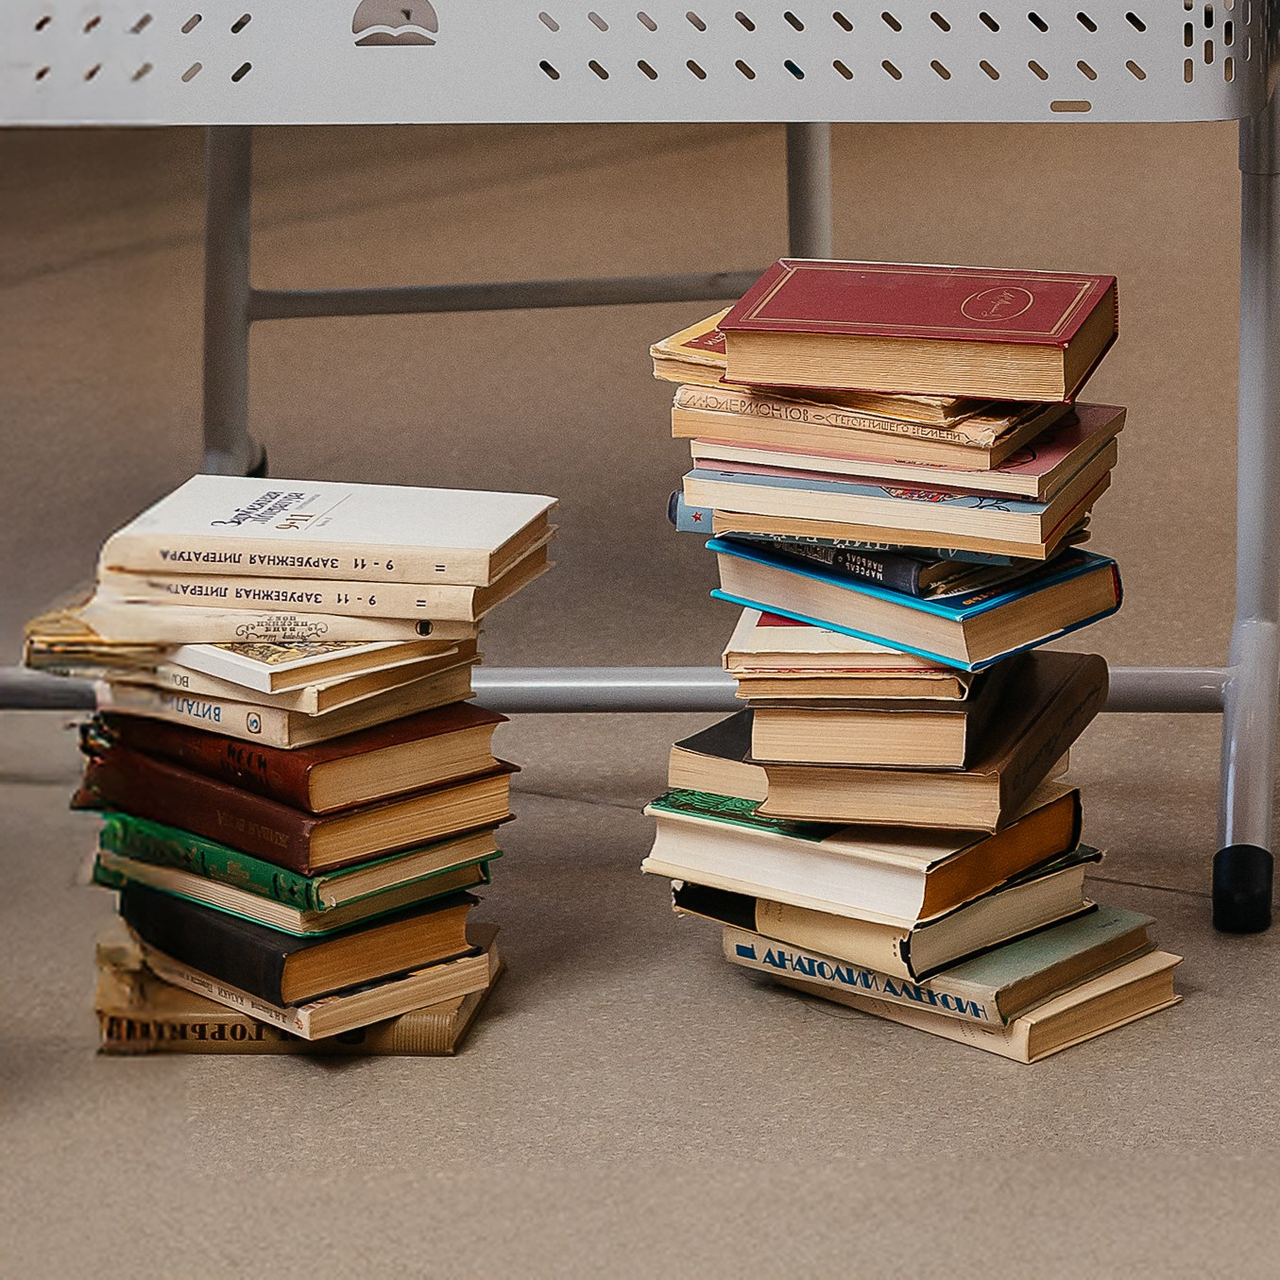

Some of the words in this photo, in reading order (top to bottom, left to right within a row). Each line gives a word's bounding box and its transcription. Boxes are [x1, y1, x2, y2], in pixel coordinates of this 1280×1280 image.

[160, 549, 243, 565] ЛИТЕРАТУРА
[248, 552, 340, 570] ЗАРУБЕЖНАЯ
[844, 552, 884, 572] ПАНЬОЛЬ
[844, 562, 884, 581] МАРСЕЛЬ
[160, 583, 229, 598] ЛИТЕРАТУ
[234, 587, 323, 605] ЗАРУБЕЖНАЯ
[762, 947, 879, 993] АНАТОЛИЙ
[882, 977, 989, 1022] АЛЕКСИН
[132, 1020, 267, 1043] ГОРЬК
